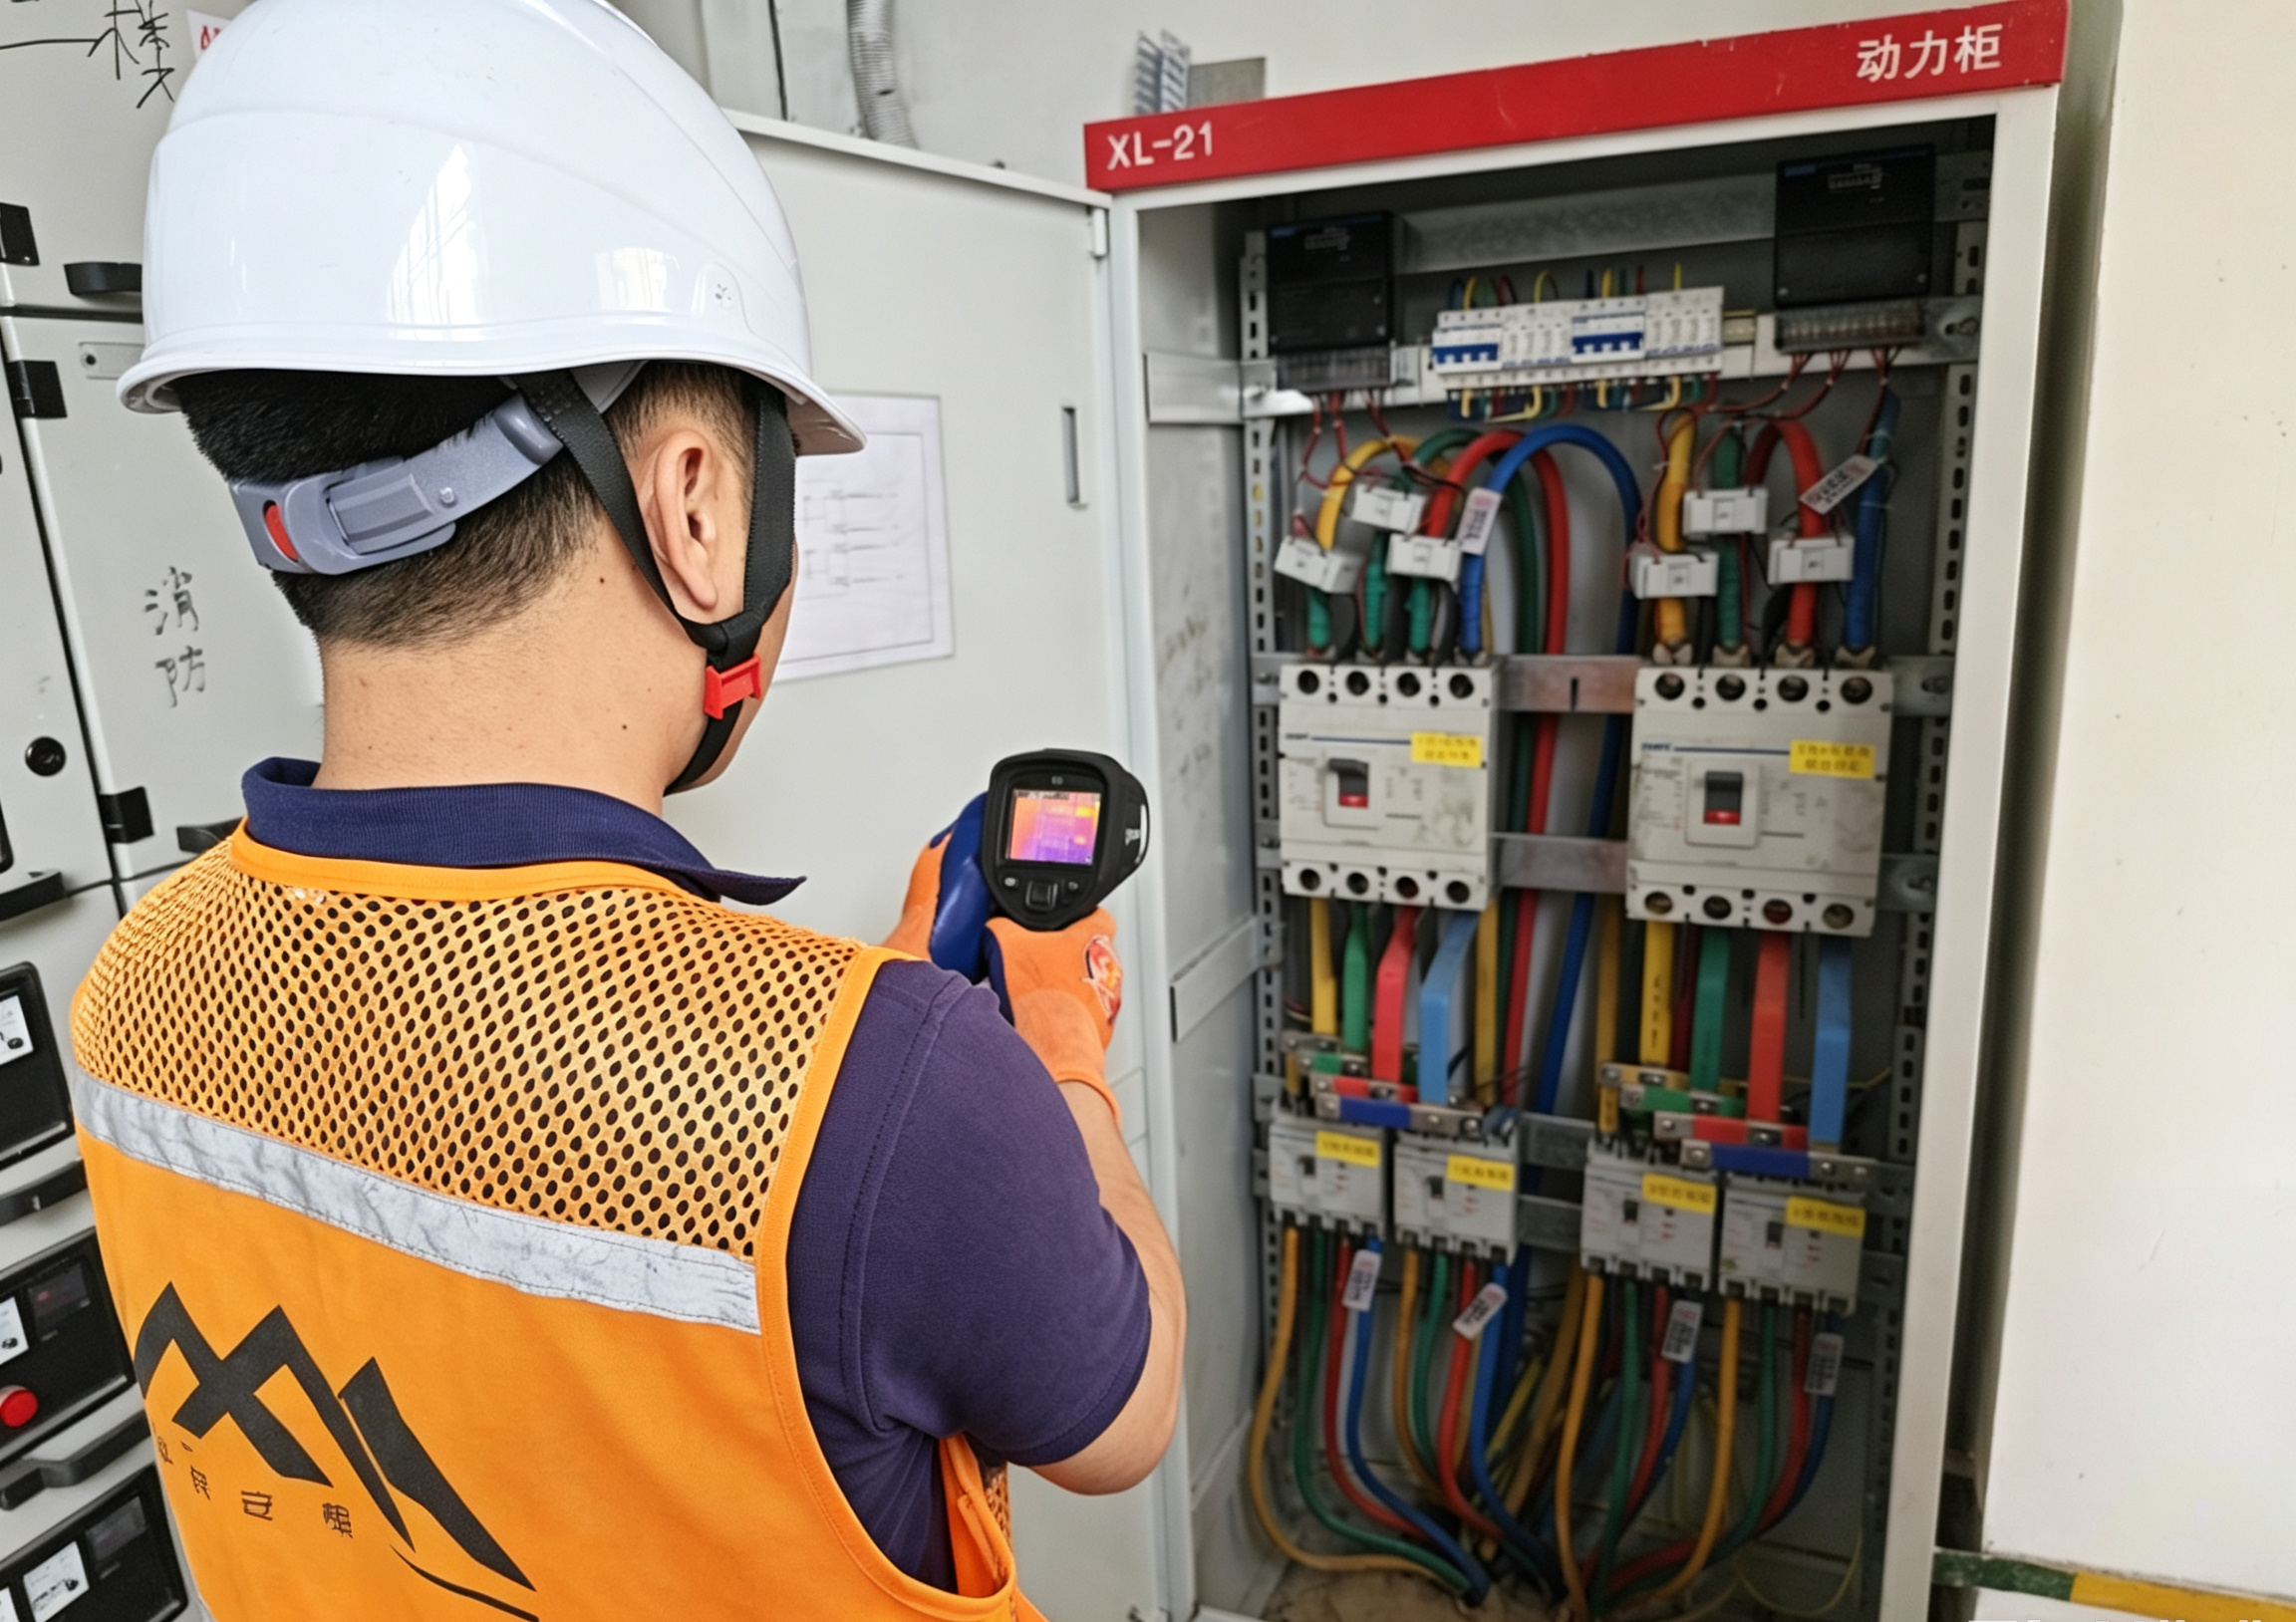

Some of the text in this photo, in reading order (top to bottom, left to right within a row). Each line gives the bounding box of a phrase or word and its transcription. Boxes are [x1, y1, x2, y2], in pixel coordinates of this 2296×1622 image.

[1856, 24, 2003, 83] 动力柜
[1107, 121, 1213, 170] XL-21
[144, 565, 206, 708] 消防
